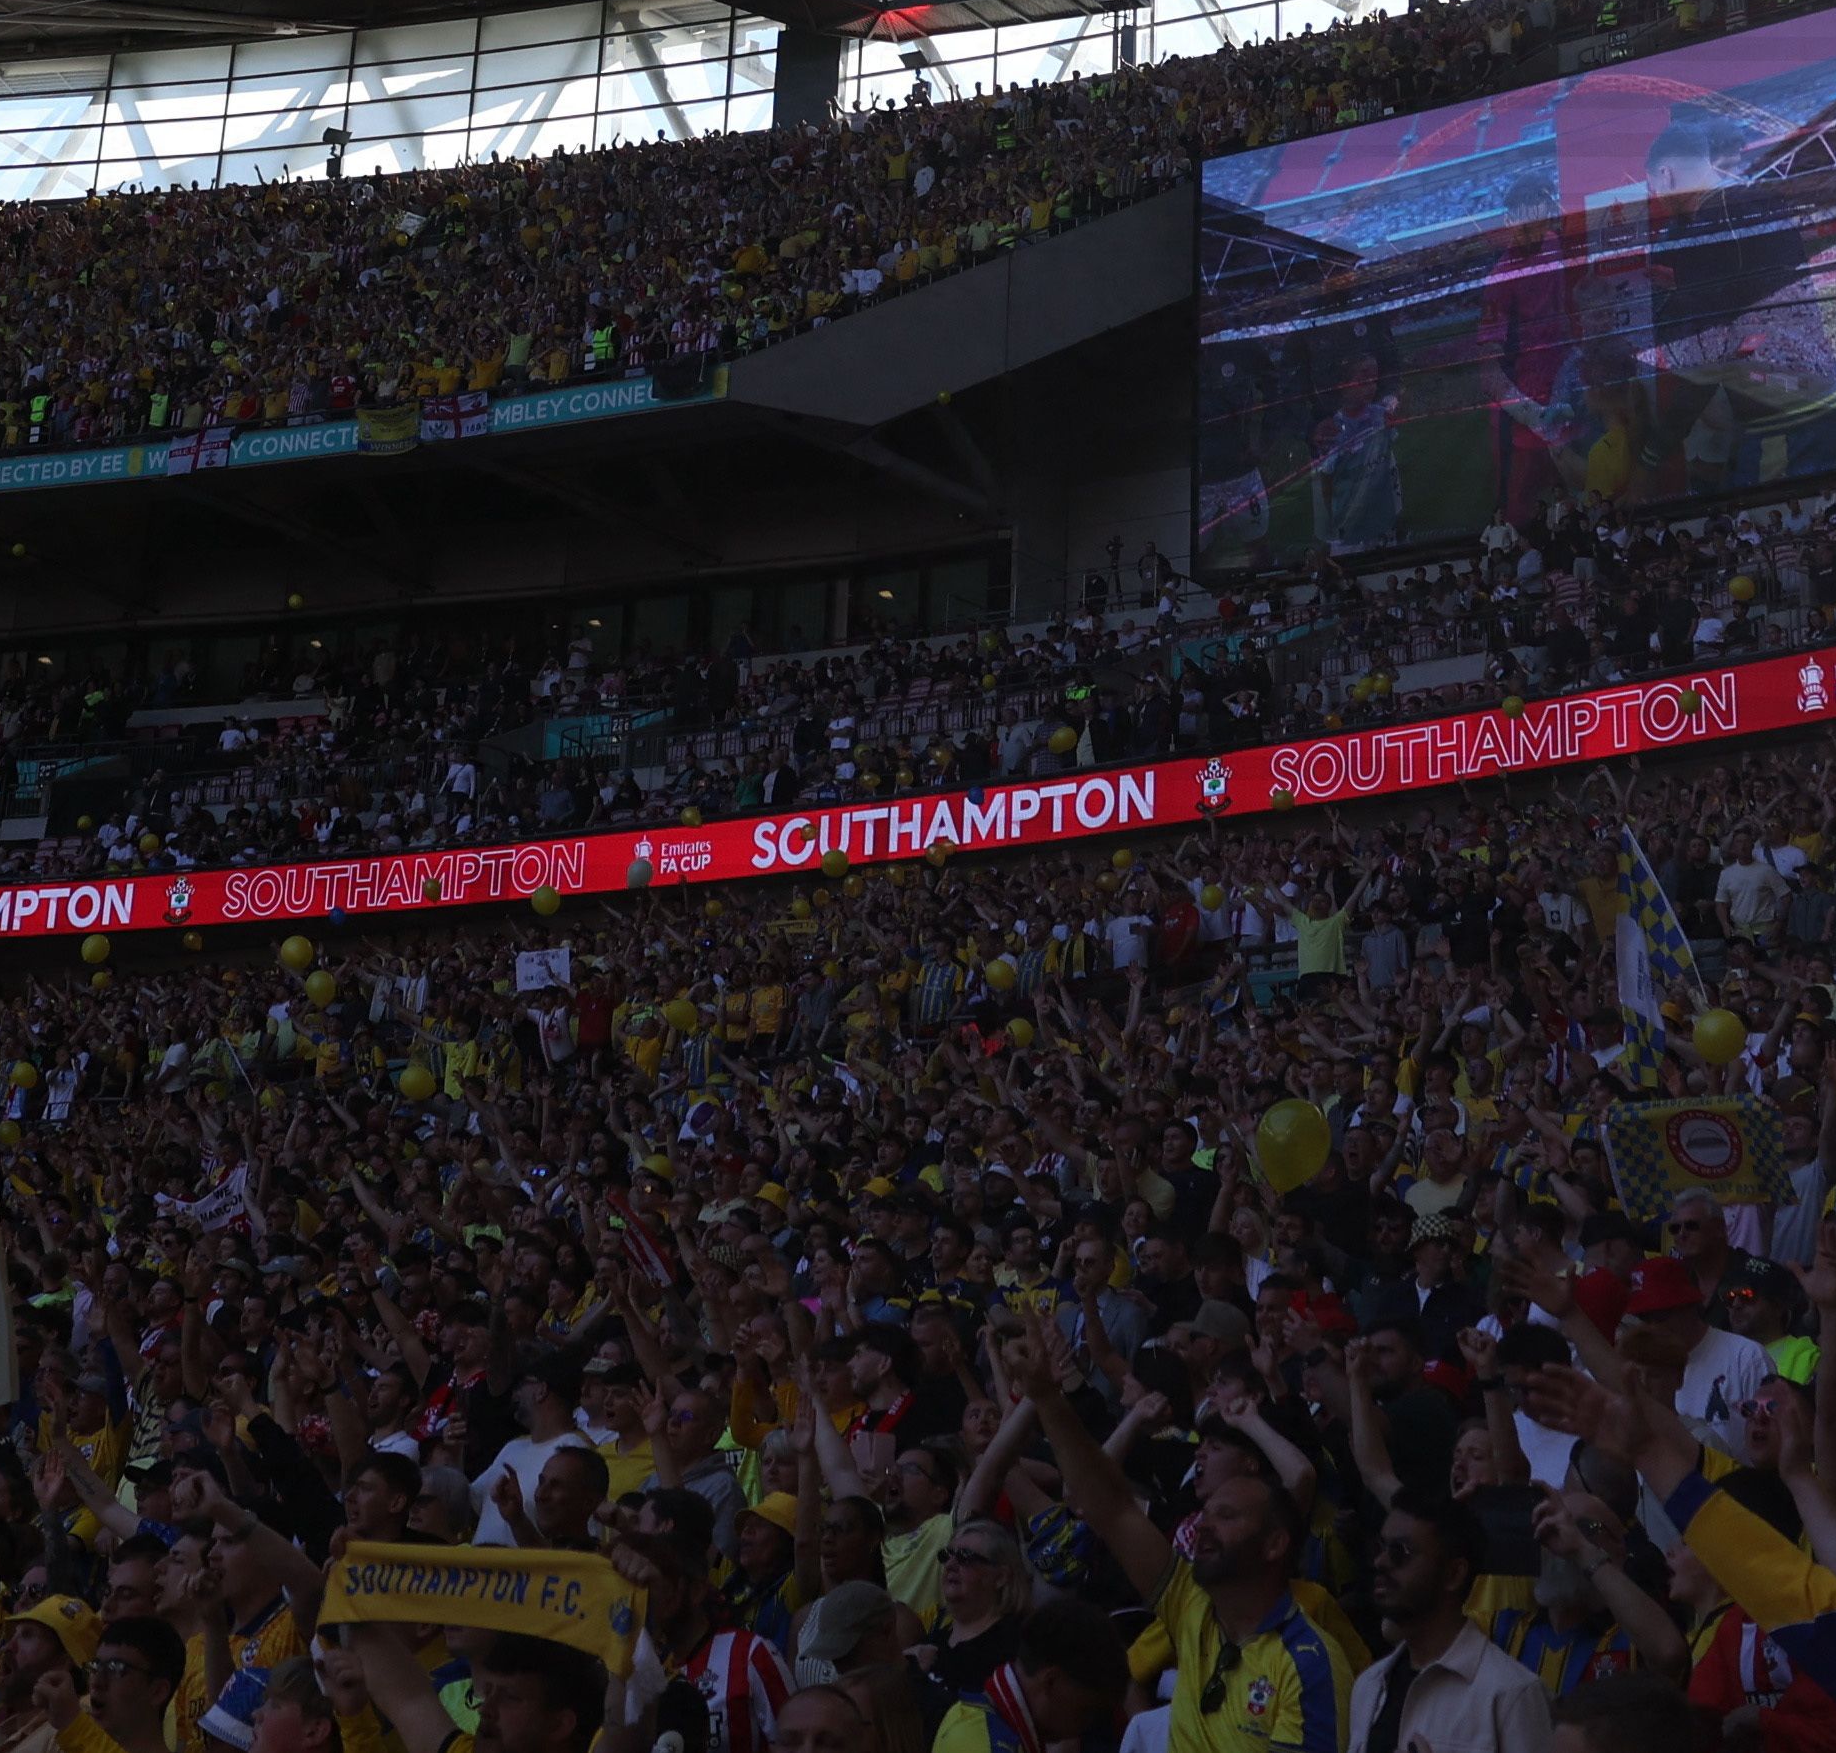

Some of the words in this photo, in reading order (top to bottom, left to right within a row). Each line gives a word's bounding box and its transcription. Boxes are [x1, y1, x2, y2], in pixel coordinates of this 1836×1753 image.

[492, 397, 565, 426] MBLEY
[249, 425, 359, 457] CONNECTE
[69, 455, 99, 478] BY
[100, 453, 123, 474] EE
[1269, 673, 1737, 800] SOUTHAMPTON
[751, 771, 1155, 869] SOUTHAMPTON
[659, 857, 680, 875] FA
[681, 853, 711, 872] CUP
[660, 838, 712, 859] Emirates
[221, 844, 585, 919] SOUTHAMPTON
[344, 1562, 531, 1606] SOUTHAMPTON
[540, 1576, 586, 1620] F.C.
